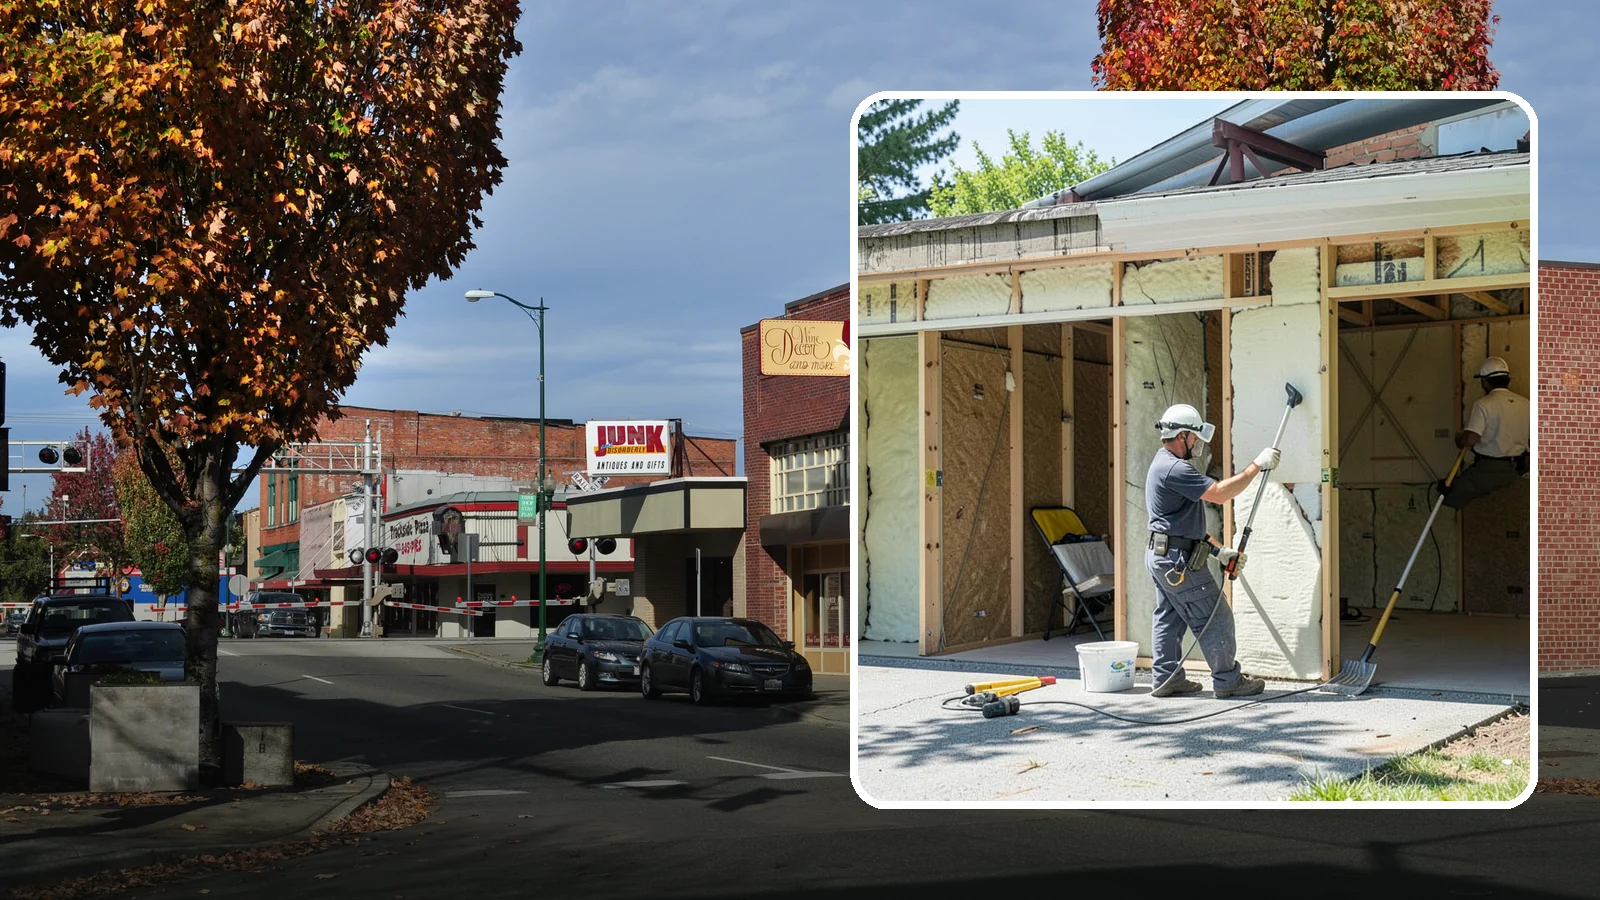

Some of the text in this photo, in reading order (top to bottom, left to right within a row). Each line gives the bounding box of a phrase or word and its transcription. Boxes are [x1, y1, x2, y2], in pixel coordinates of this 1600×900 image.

[595, 425, 665, 457] JUNK
[597, 460, 665, 470] ANTIQUES AND GIFTS
[390, 519, 429, 540] Trackside Pizza
